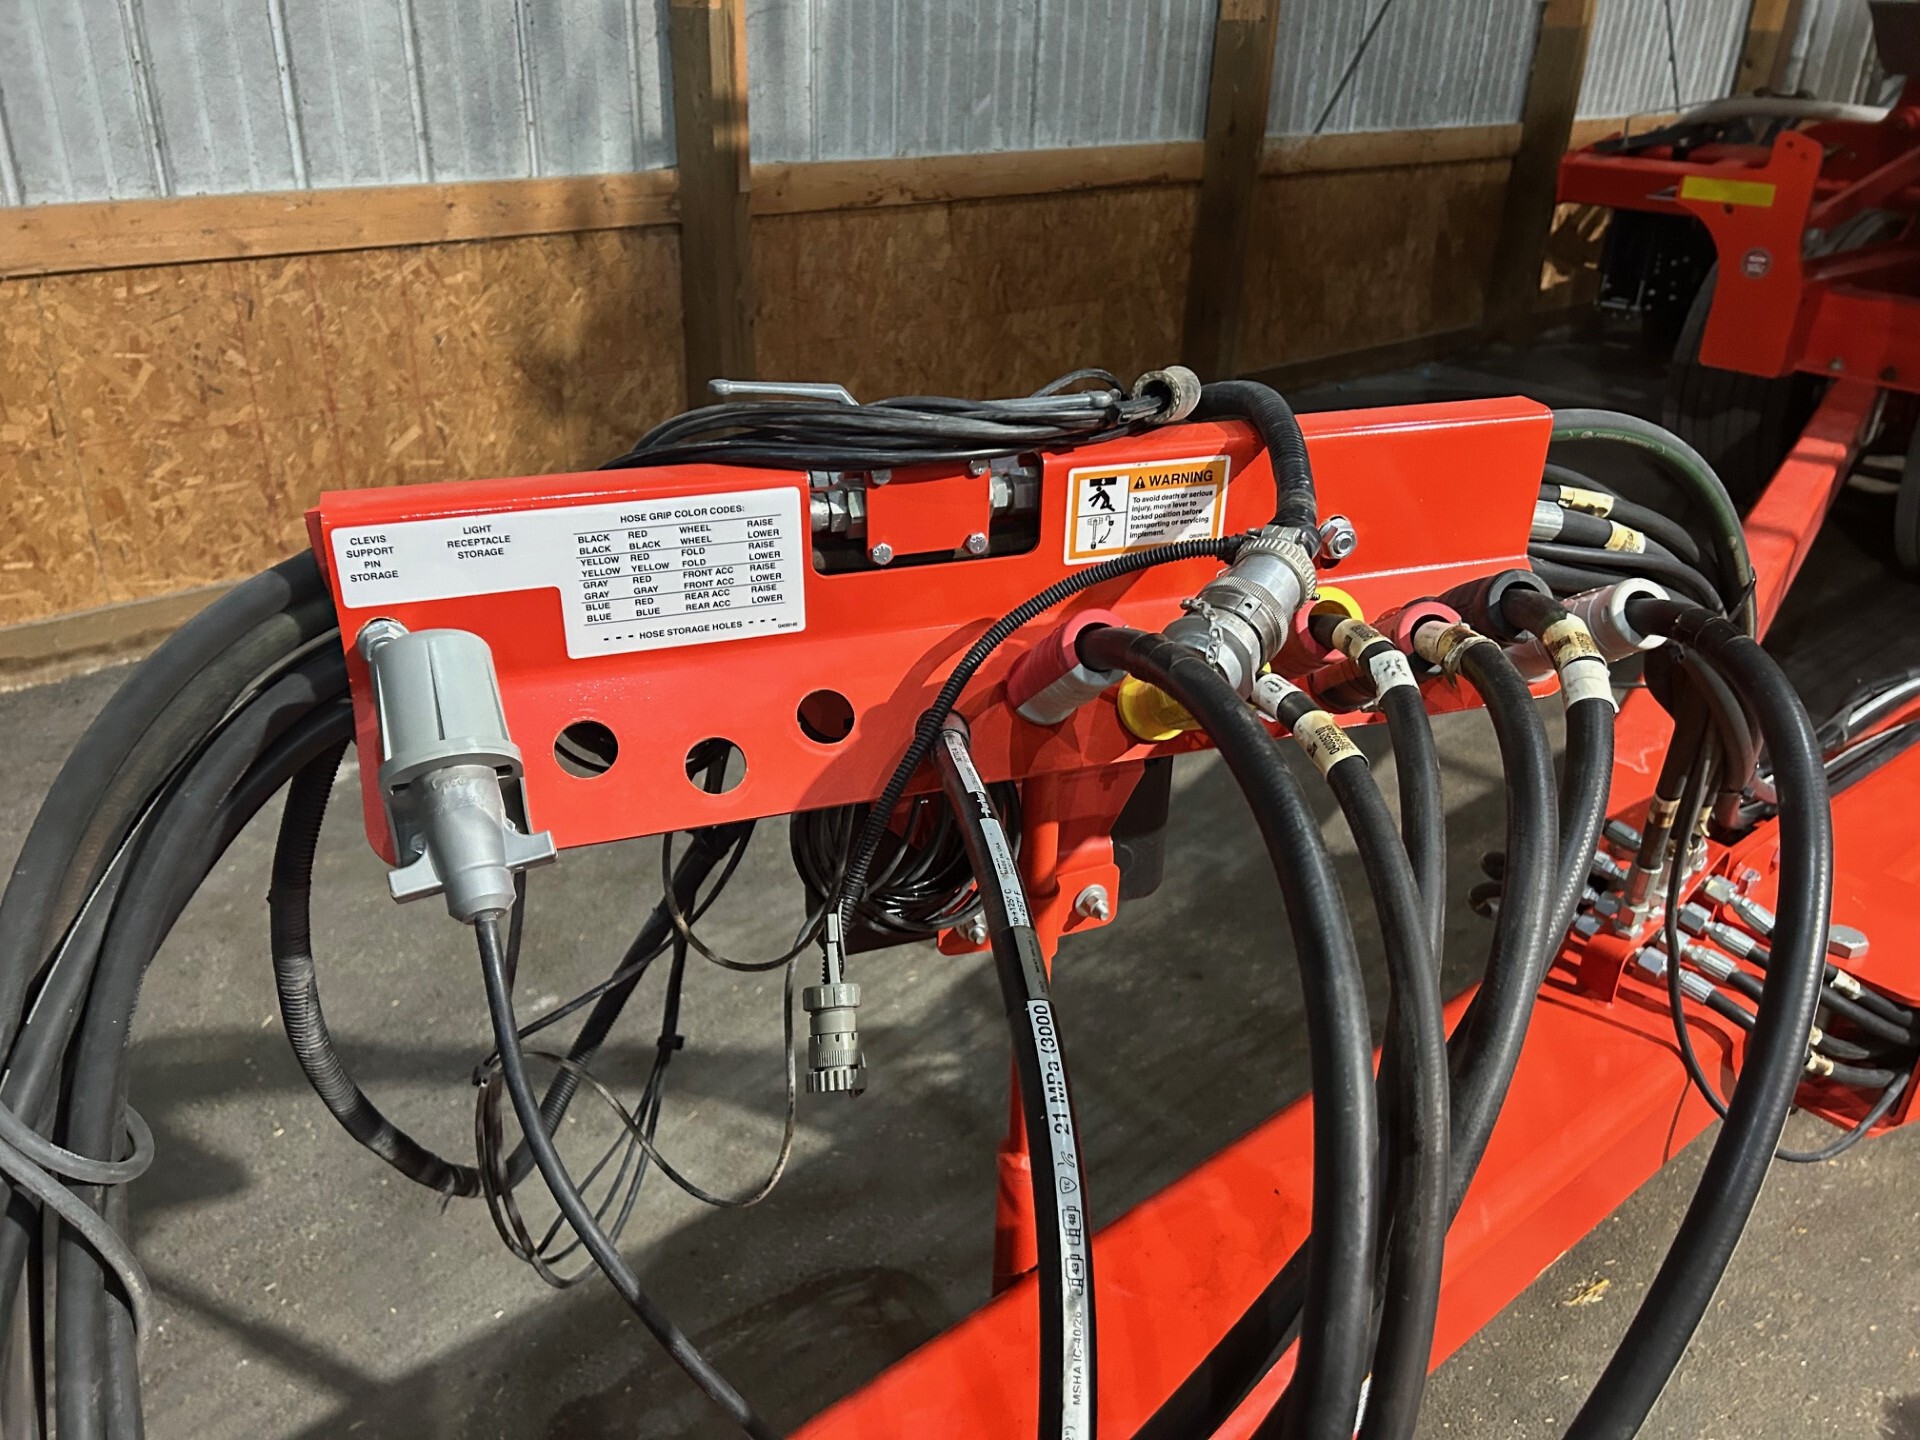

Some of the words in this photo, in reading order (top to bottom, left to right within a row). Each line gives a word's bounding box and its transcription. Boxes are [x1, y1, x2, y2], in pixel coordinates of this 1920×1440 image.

[1149, 470, 1213, 486] WARNING
[1162, 493, 1180, 501] death
[620, 514, 647, 523] HOSE
[649, 511, 672, 520] GRIP
[674, 508, 707, 518] COLOR
[710, 505, 745, 515] CODES:
[1131, 512, 1152, 521] locked
[1154, 510, 1180, 520] position
[1132, 504, 1152, 513] injury,
[463, 525, 492, 534] LIGHT
[578, 534, 610, 543] BLACK
[628, 530, 648, 539] RED
[679, 524, 711, 534] WHEEL
[747, 518, 773, 527] RAISE
[1130, 520, 1170, 530] transporting
[1180, 516, 1209, 525] servicing
[350, 535, 386, 546] CLEVIS
[447, 535, 511, 548] RECEPTACLE
[580, 545, 611, 555] BLACK
[629, 540, 661, 550] BLACK
[680, 536, 712, 545] WHEEL
[748, 529, 779, 538] LOWER
[1130, 529, 1165, 539] implement.
[346, 546, 394, 558] SUPPORT
[458, 548, 504, 559] STORAGE
[581, 556, 620, 566] YELLOW
[630, 553, 650, 561] RED
[681, 548, 705, 556] FOLD
[748, 541, 774, 549] RAISE
[364, 561, 381, 569] PIN
[582, 567, 621, 577] YELLOW
[631, 562, 669, 572] YELLOW
[682, 559, 706, 567] FOLD
[749, 551, 780, 560] LOWER
[350, 570, 399, 582] STORAGE
[583, 580, 608, 589] GRAY
[633, 575, 652, 584] RED
[683, 569, 712, 578] FRONT
[716, 566, 734, 575] ACC
[750, 562, 776, 571] RAISE
[584, 591, 610, 600] GRAY
[634, 586, 658, 594] GRAY
[684, 580, 713, 589] FRONT
[716, 578, 734, 586] ACC
[750, 572, 782, 582] LOWER
[586, 602, 610, 611] BLUE
[635, 598, 654, 606] RED
[685, 591, 709, 600] REAR
[712, 589, 730, 597] ACC
[751, 584, 777, 593] RAISE
[587, 613, 612, 622] BLUE
[636, 607, 660, 616] BLUE
[686, 602, 710, 611] REAR
[713, 600, 731, 608] ACC
[752, 594, 783, 604] LOWER
[639, 630, 664, 639] HOSE
[667, 624, 710, 636] STORAGE
[712, 621, 742, 630] HOLES
[1033, 1005, 1057, 1053] (3000
[1046, 1061, 1065, 1103] MPa
[1052, 1113, 1069, 1135] 21
[1068, 1214, 1076, 1225] 48
[1072, 1263, 1079, 1275] 43
[1073, 1367, 1082, 1405] MSHA
